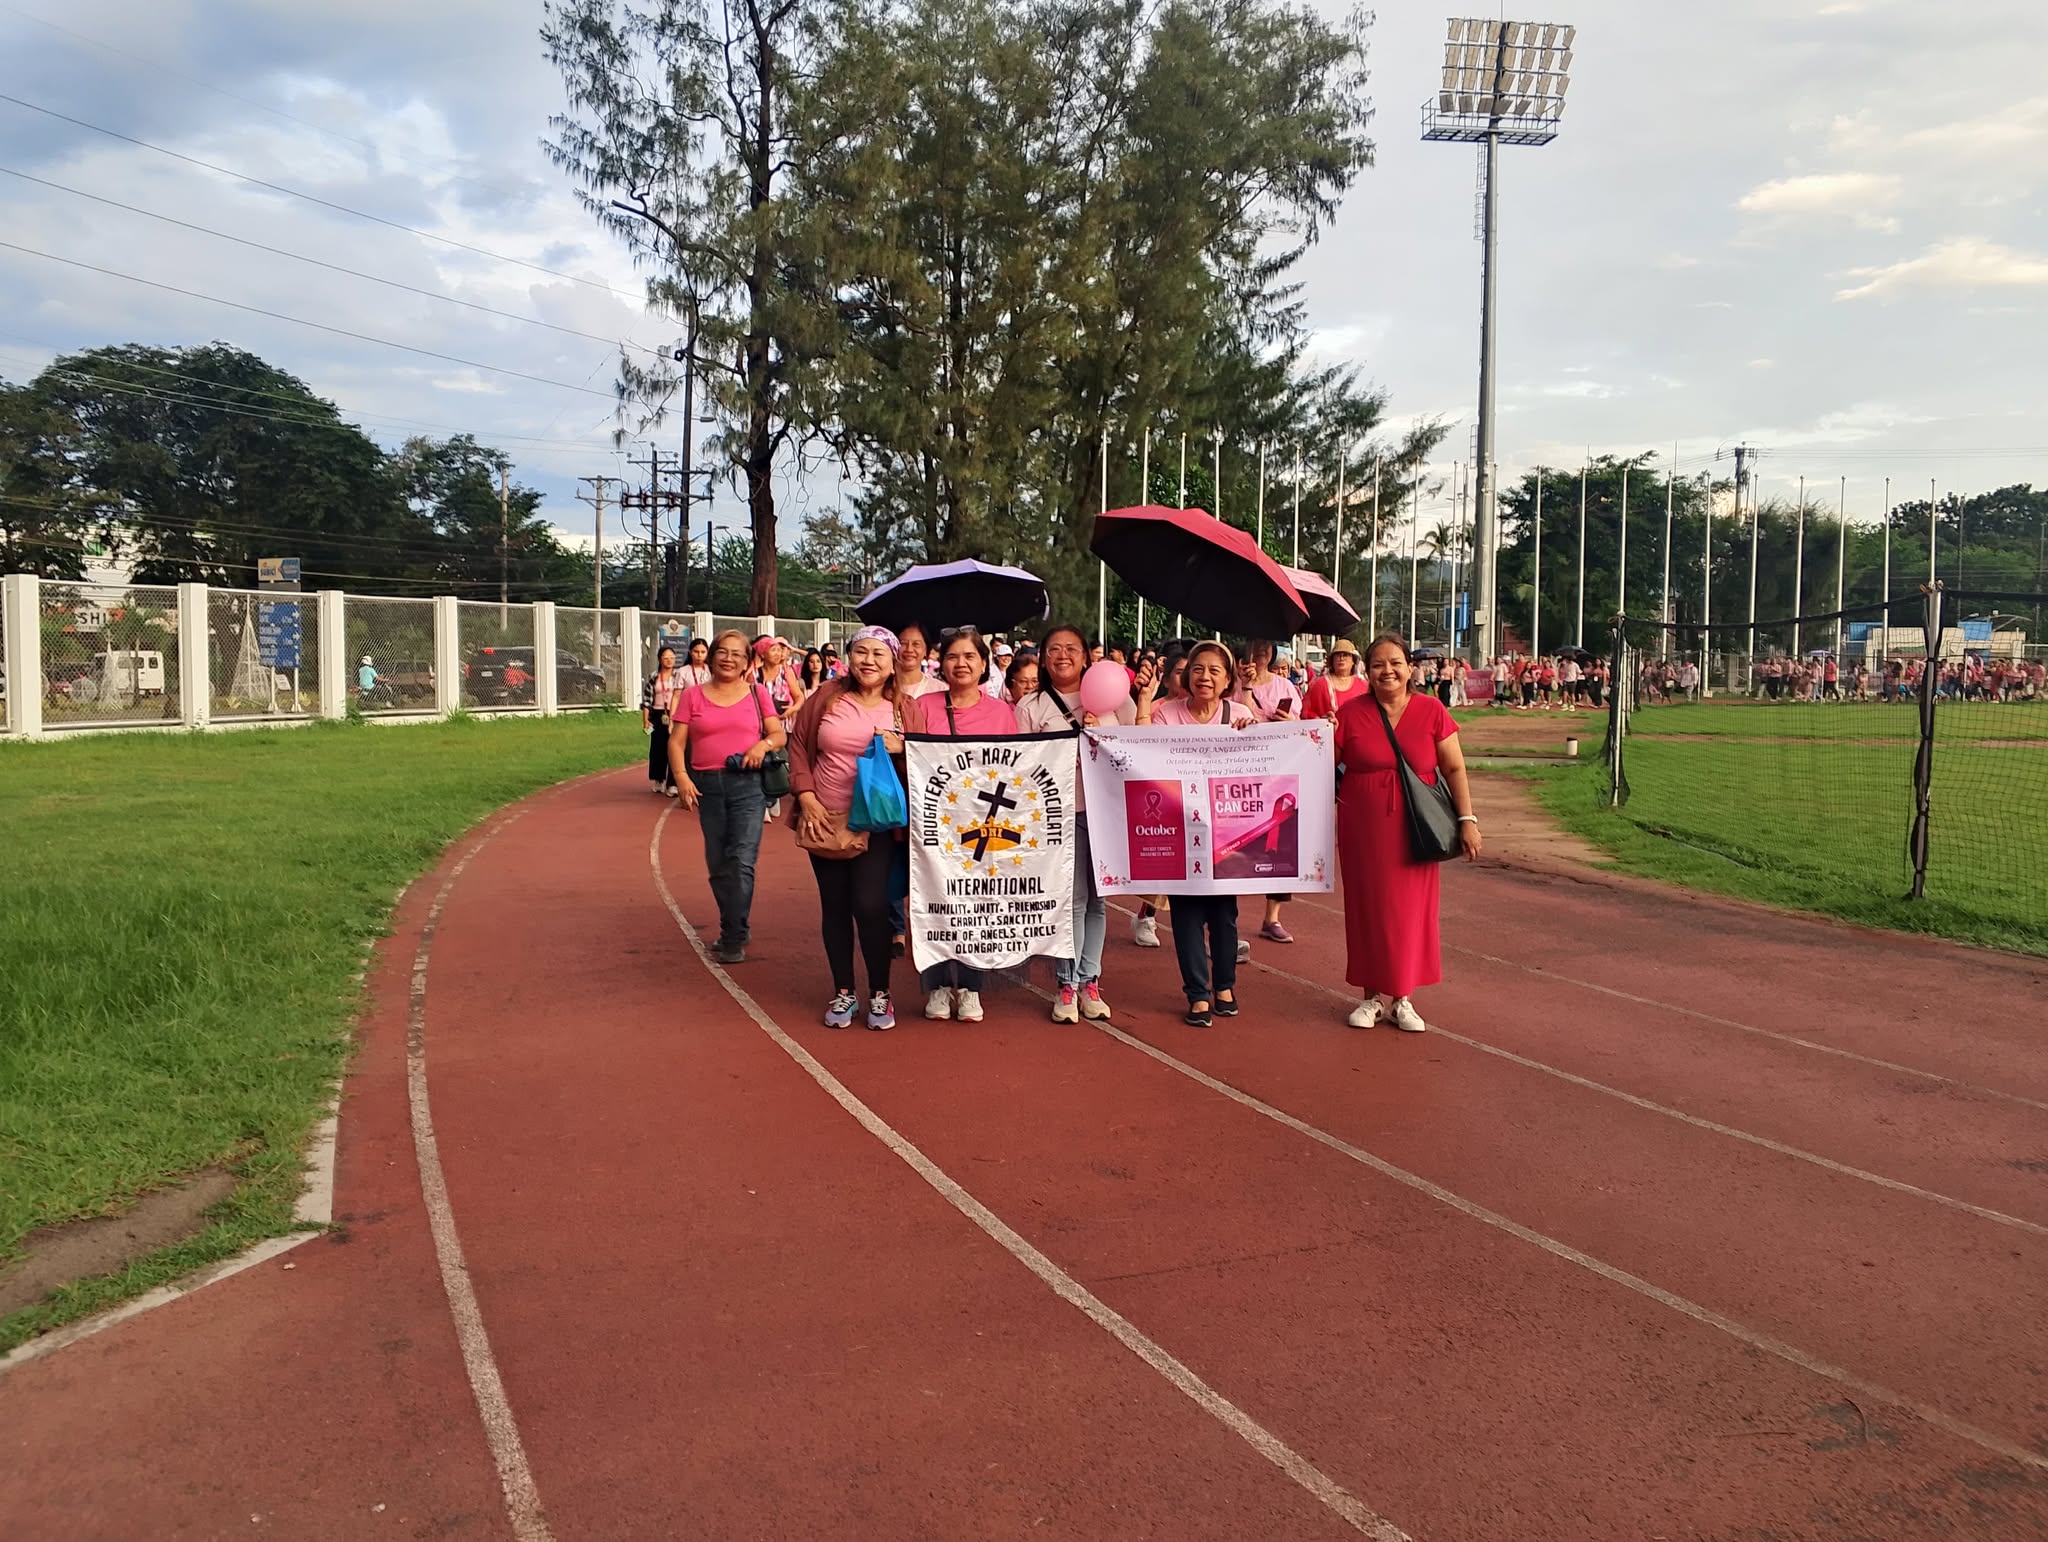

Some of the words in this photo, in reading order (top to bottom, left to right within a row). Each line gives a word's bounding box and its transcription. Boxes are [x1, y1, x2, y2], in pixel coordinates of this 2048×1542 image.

[1236, 734, 1289, 742] INTERNATIONAL
[1169, 746, 1197, 754] QUEEN
[1199, 746, 1210, 754] OF
[1210, 745, 1242, 753] ANGELS
[1223, 756, 1250, 764] Friday
[924, 765, 952, 846] DAUGHTERS
[956, 751, 974, 771] OF
[982, 747, 1022, 767] MARY
[1030, 764, 1062, 846] IMMACULATE
[1215, 783, 1263, 799] FIGHT
[1215, 800, 1264, 813] CANCER
[1135, 824, 1177, 836] October
[946, 877, 1045, 895] INTERNATIONAL
[1008, 900, 1057, 913] FRIENDSHIP
[927, 930, 958, 941] QUEEN
[963, 930, 974, 940] OF
[980, 928, 1016, 940] ANGELS
[1023, 925, 1056, 938] CIRCLE
[955, 942, 1003, 954] OLONGAPO
[1006, 941, 1029, 952] CITY
